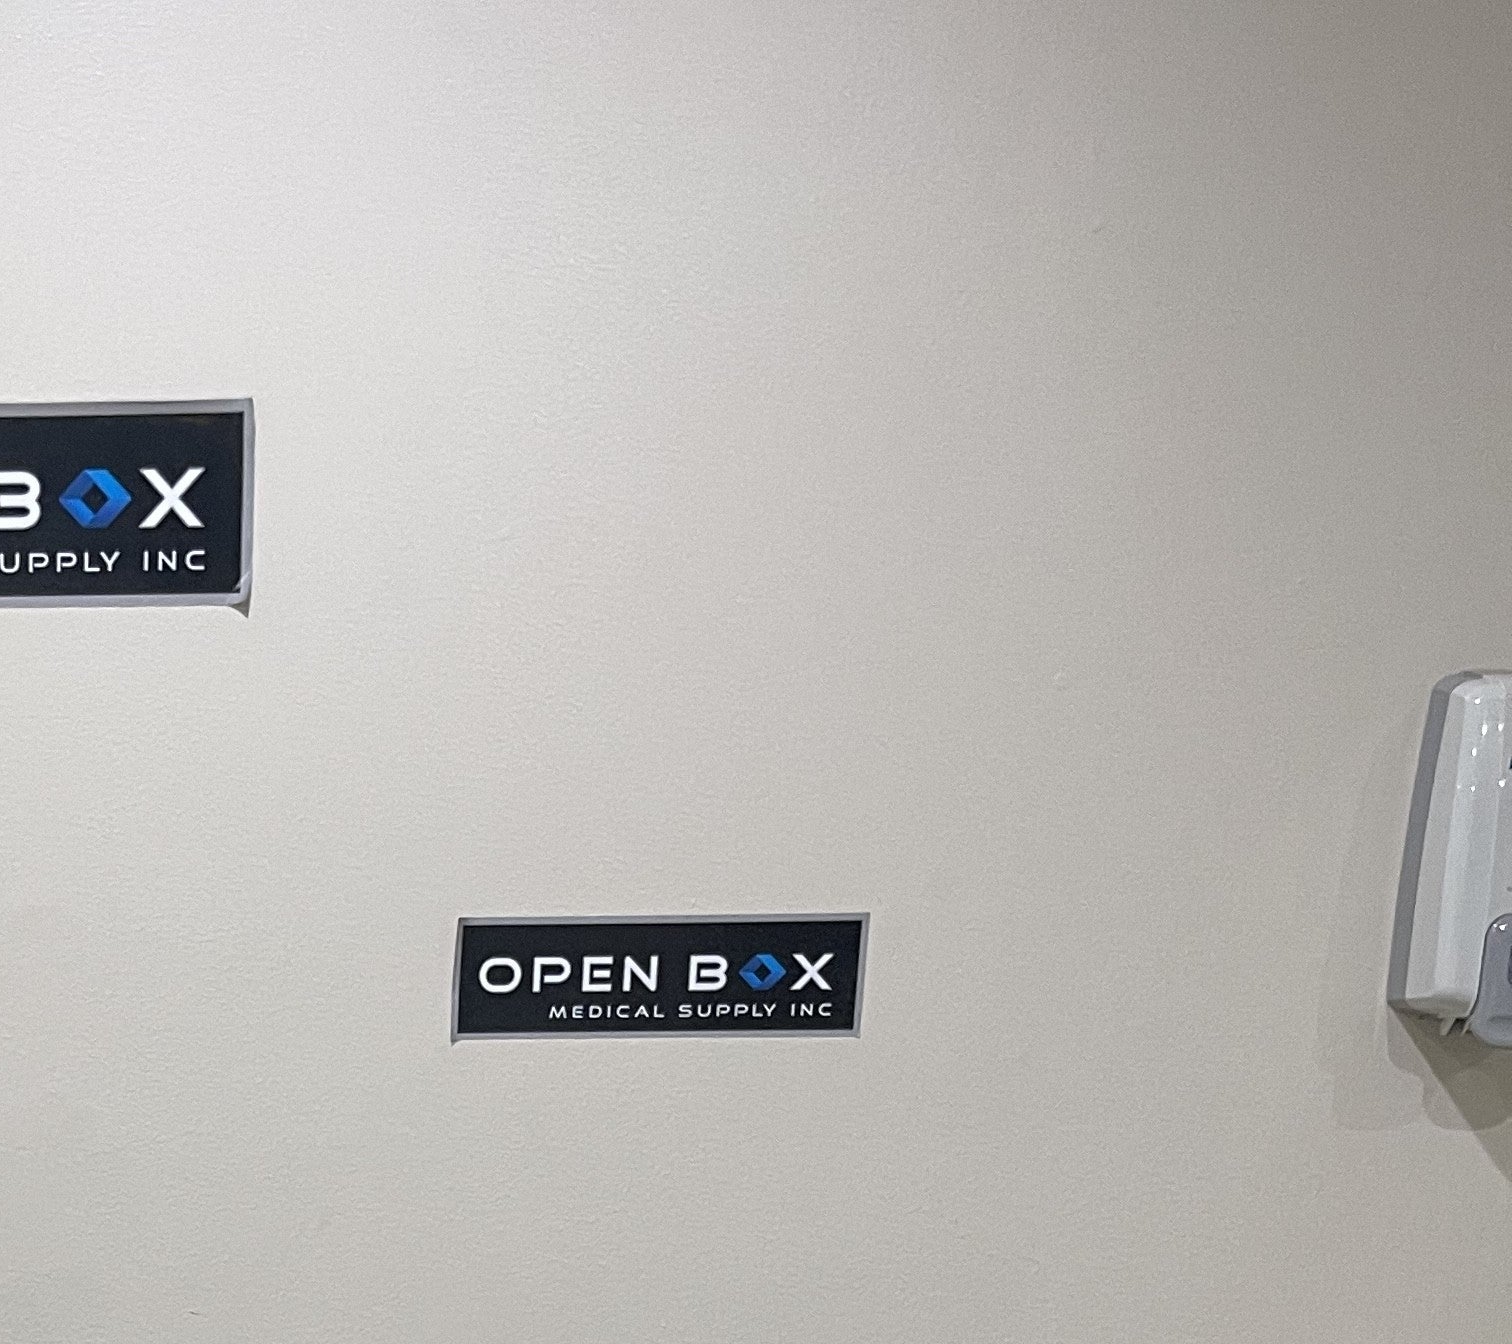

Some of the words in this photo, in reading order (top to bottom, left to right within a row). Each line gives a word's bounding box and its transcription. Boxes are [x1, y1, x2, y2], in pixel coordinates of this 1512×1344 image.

[142, 549, 206, 572] INC
[478, 955, 659, 993] OPEN
[548, 1004, 665, 1019] MEDICAL
[678, 1002, 777, 1018] SUPPLY
[790, 1002, 832, 1017] INC
